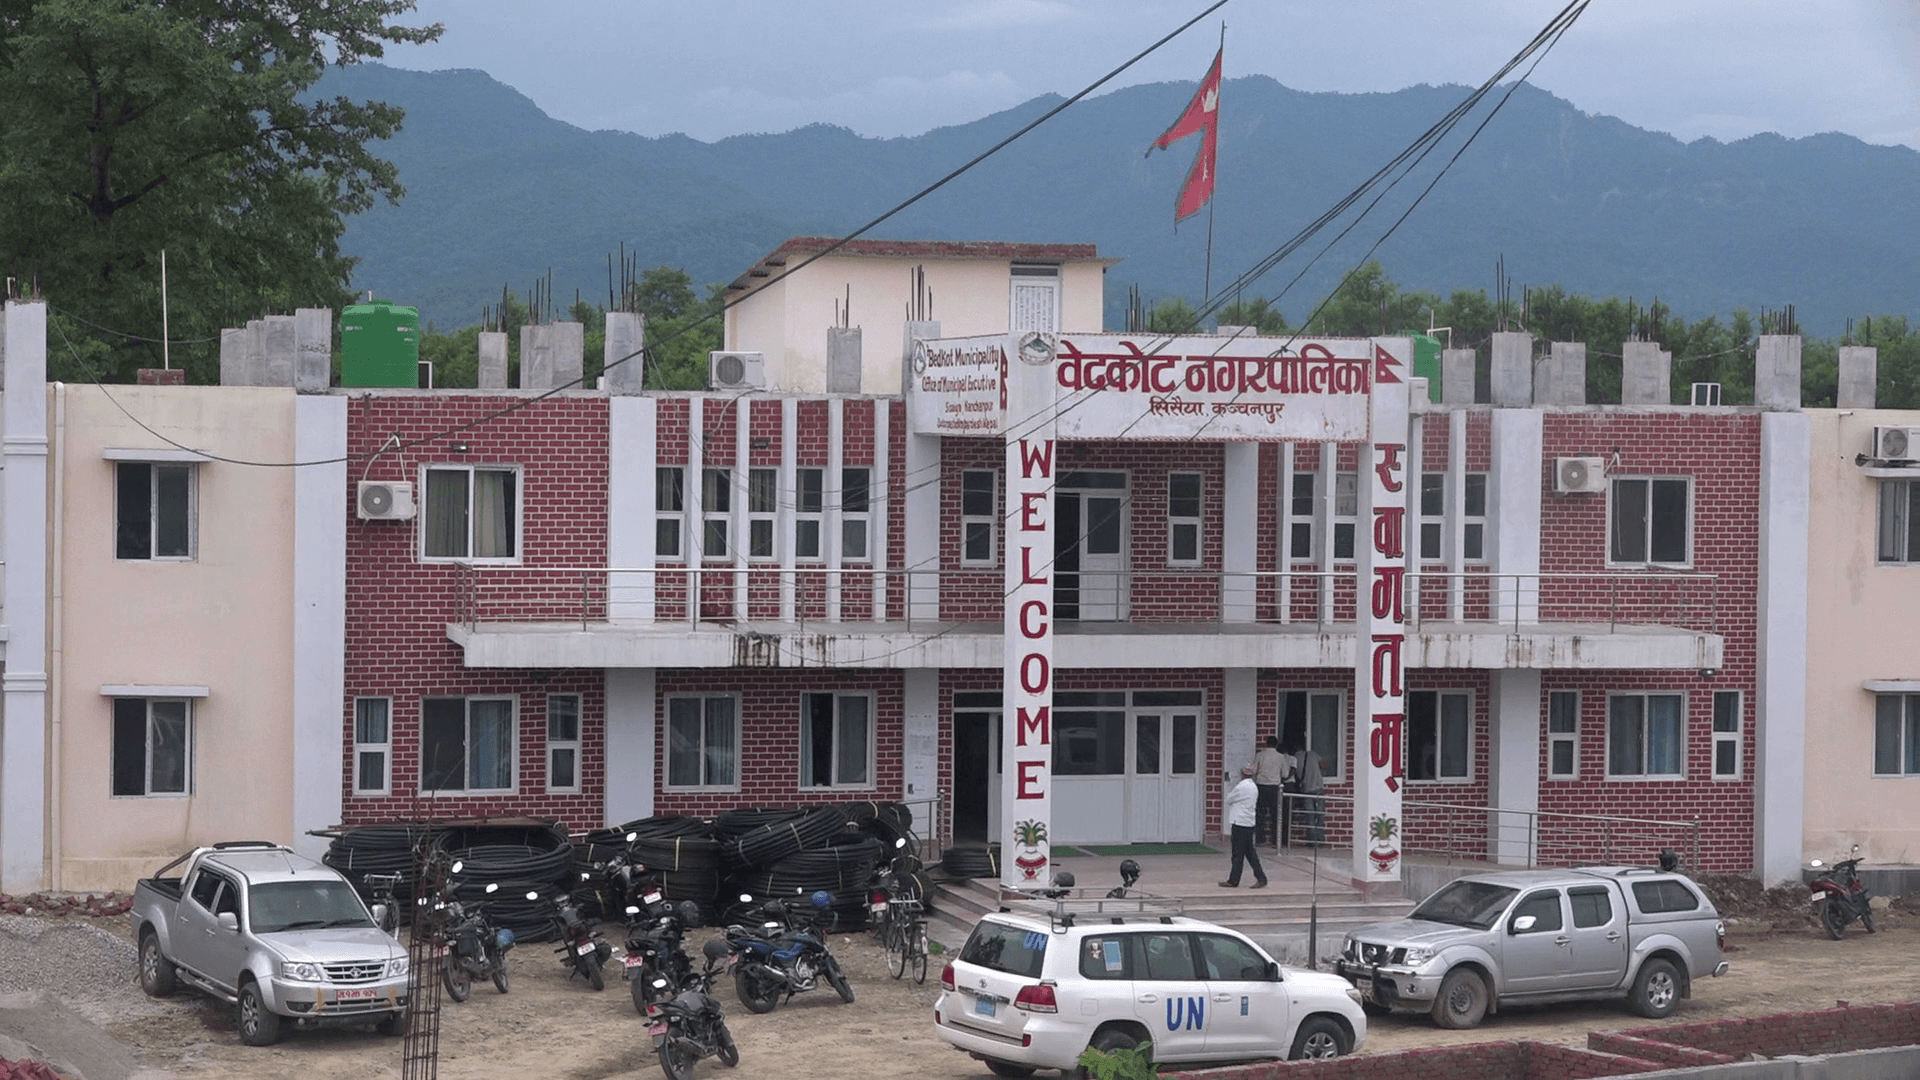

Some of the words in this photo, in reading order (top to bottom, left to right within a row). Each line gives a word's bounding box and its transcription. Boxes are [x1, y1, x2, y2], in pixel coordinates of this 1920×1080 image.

[955, 345, 999, 371] Municipality
[1056, 340, 1182, 394] वेदकोट
[1186, 343, 1372, 394] नगरपालिका
[1016, 439, 1053, 800] WELCOME
[1371, 444, 1405, 793] स्वागतम्
[1022, 931, 1048, 951] UN
[1166, 996, 1205, 1032] UN
